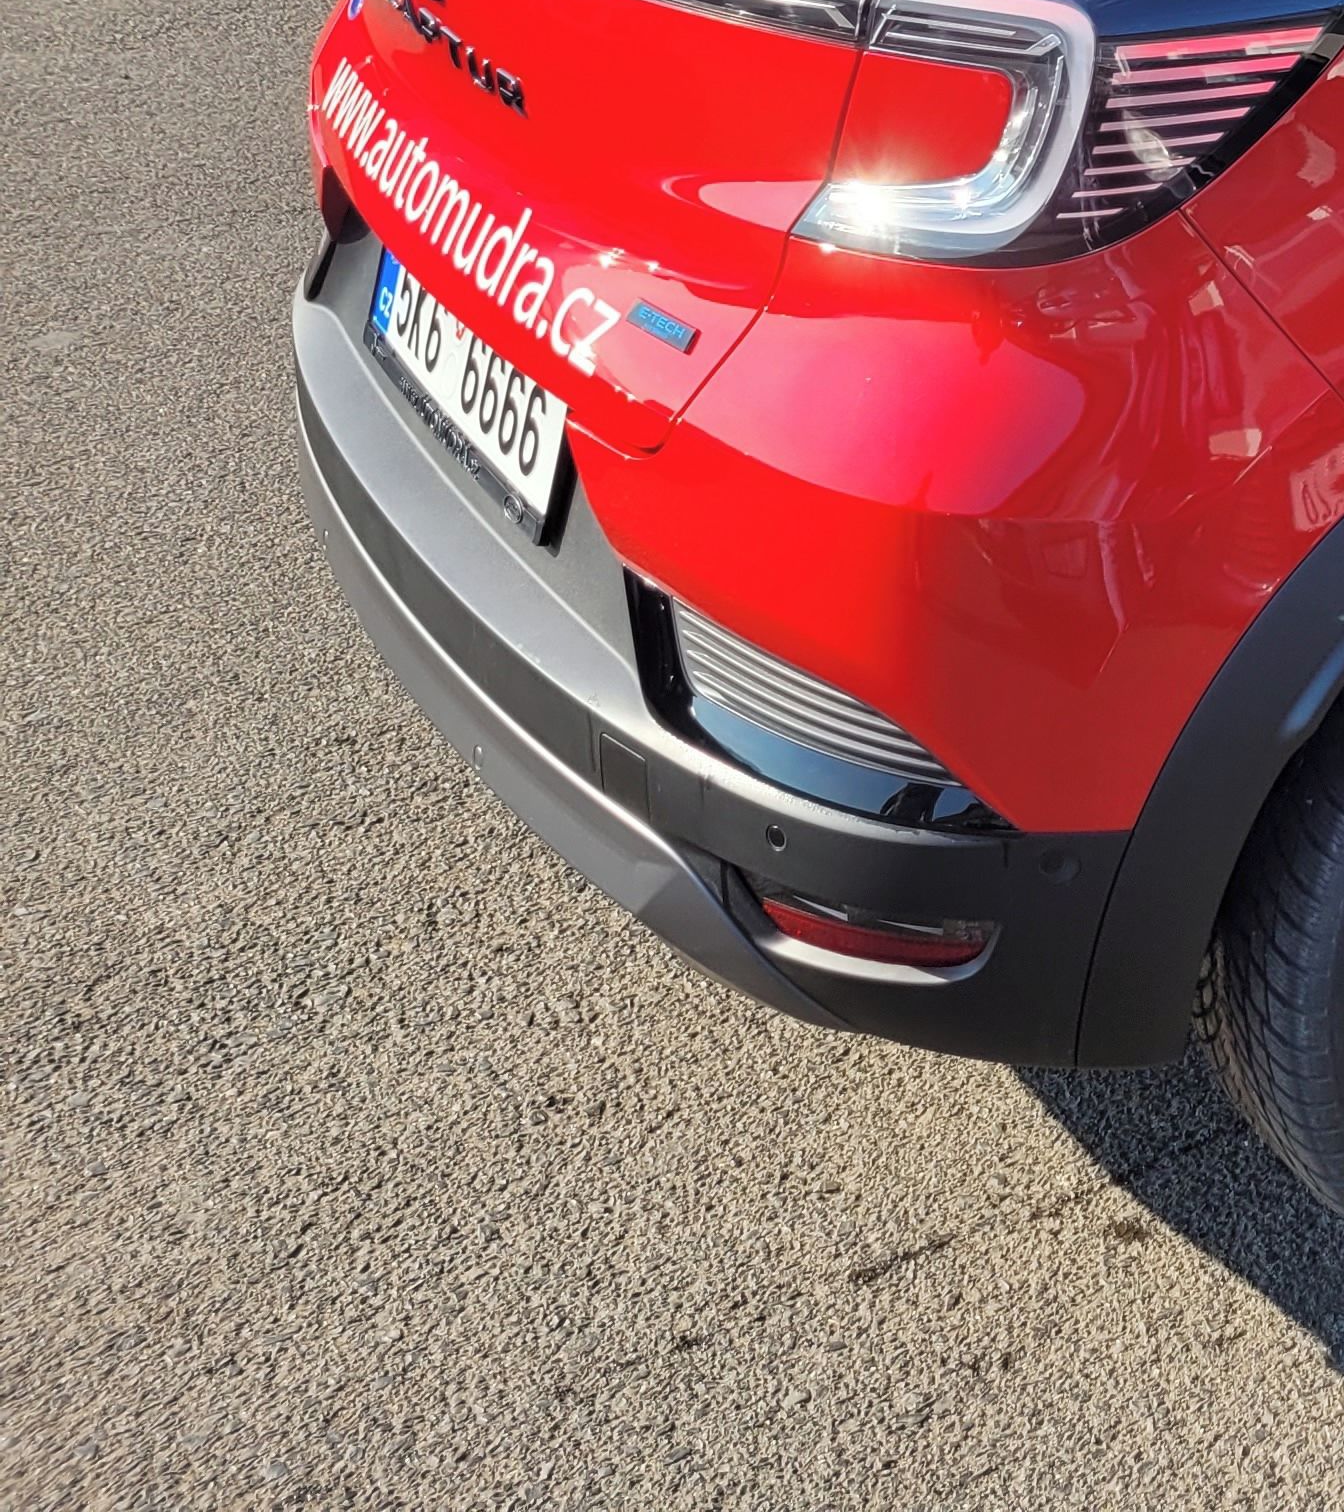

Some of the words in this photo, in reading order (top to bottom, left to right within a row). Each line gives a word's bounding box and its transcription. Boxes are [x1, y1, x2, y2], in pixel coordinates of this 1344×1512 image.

[322, 57, 621, 377] www.automudra.cz
[379, 287, 393, 318] CZ
[639, 306, 685, 339] E-TECH
[396, 271, 449, 373] 5K6
[461, 336, 547, 476] 6666
